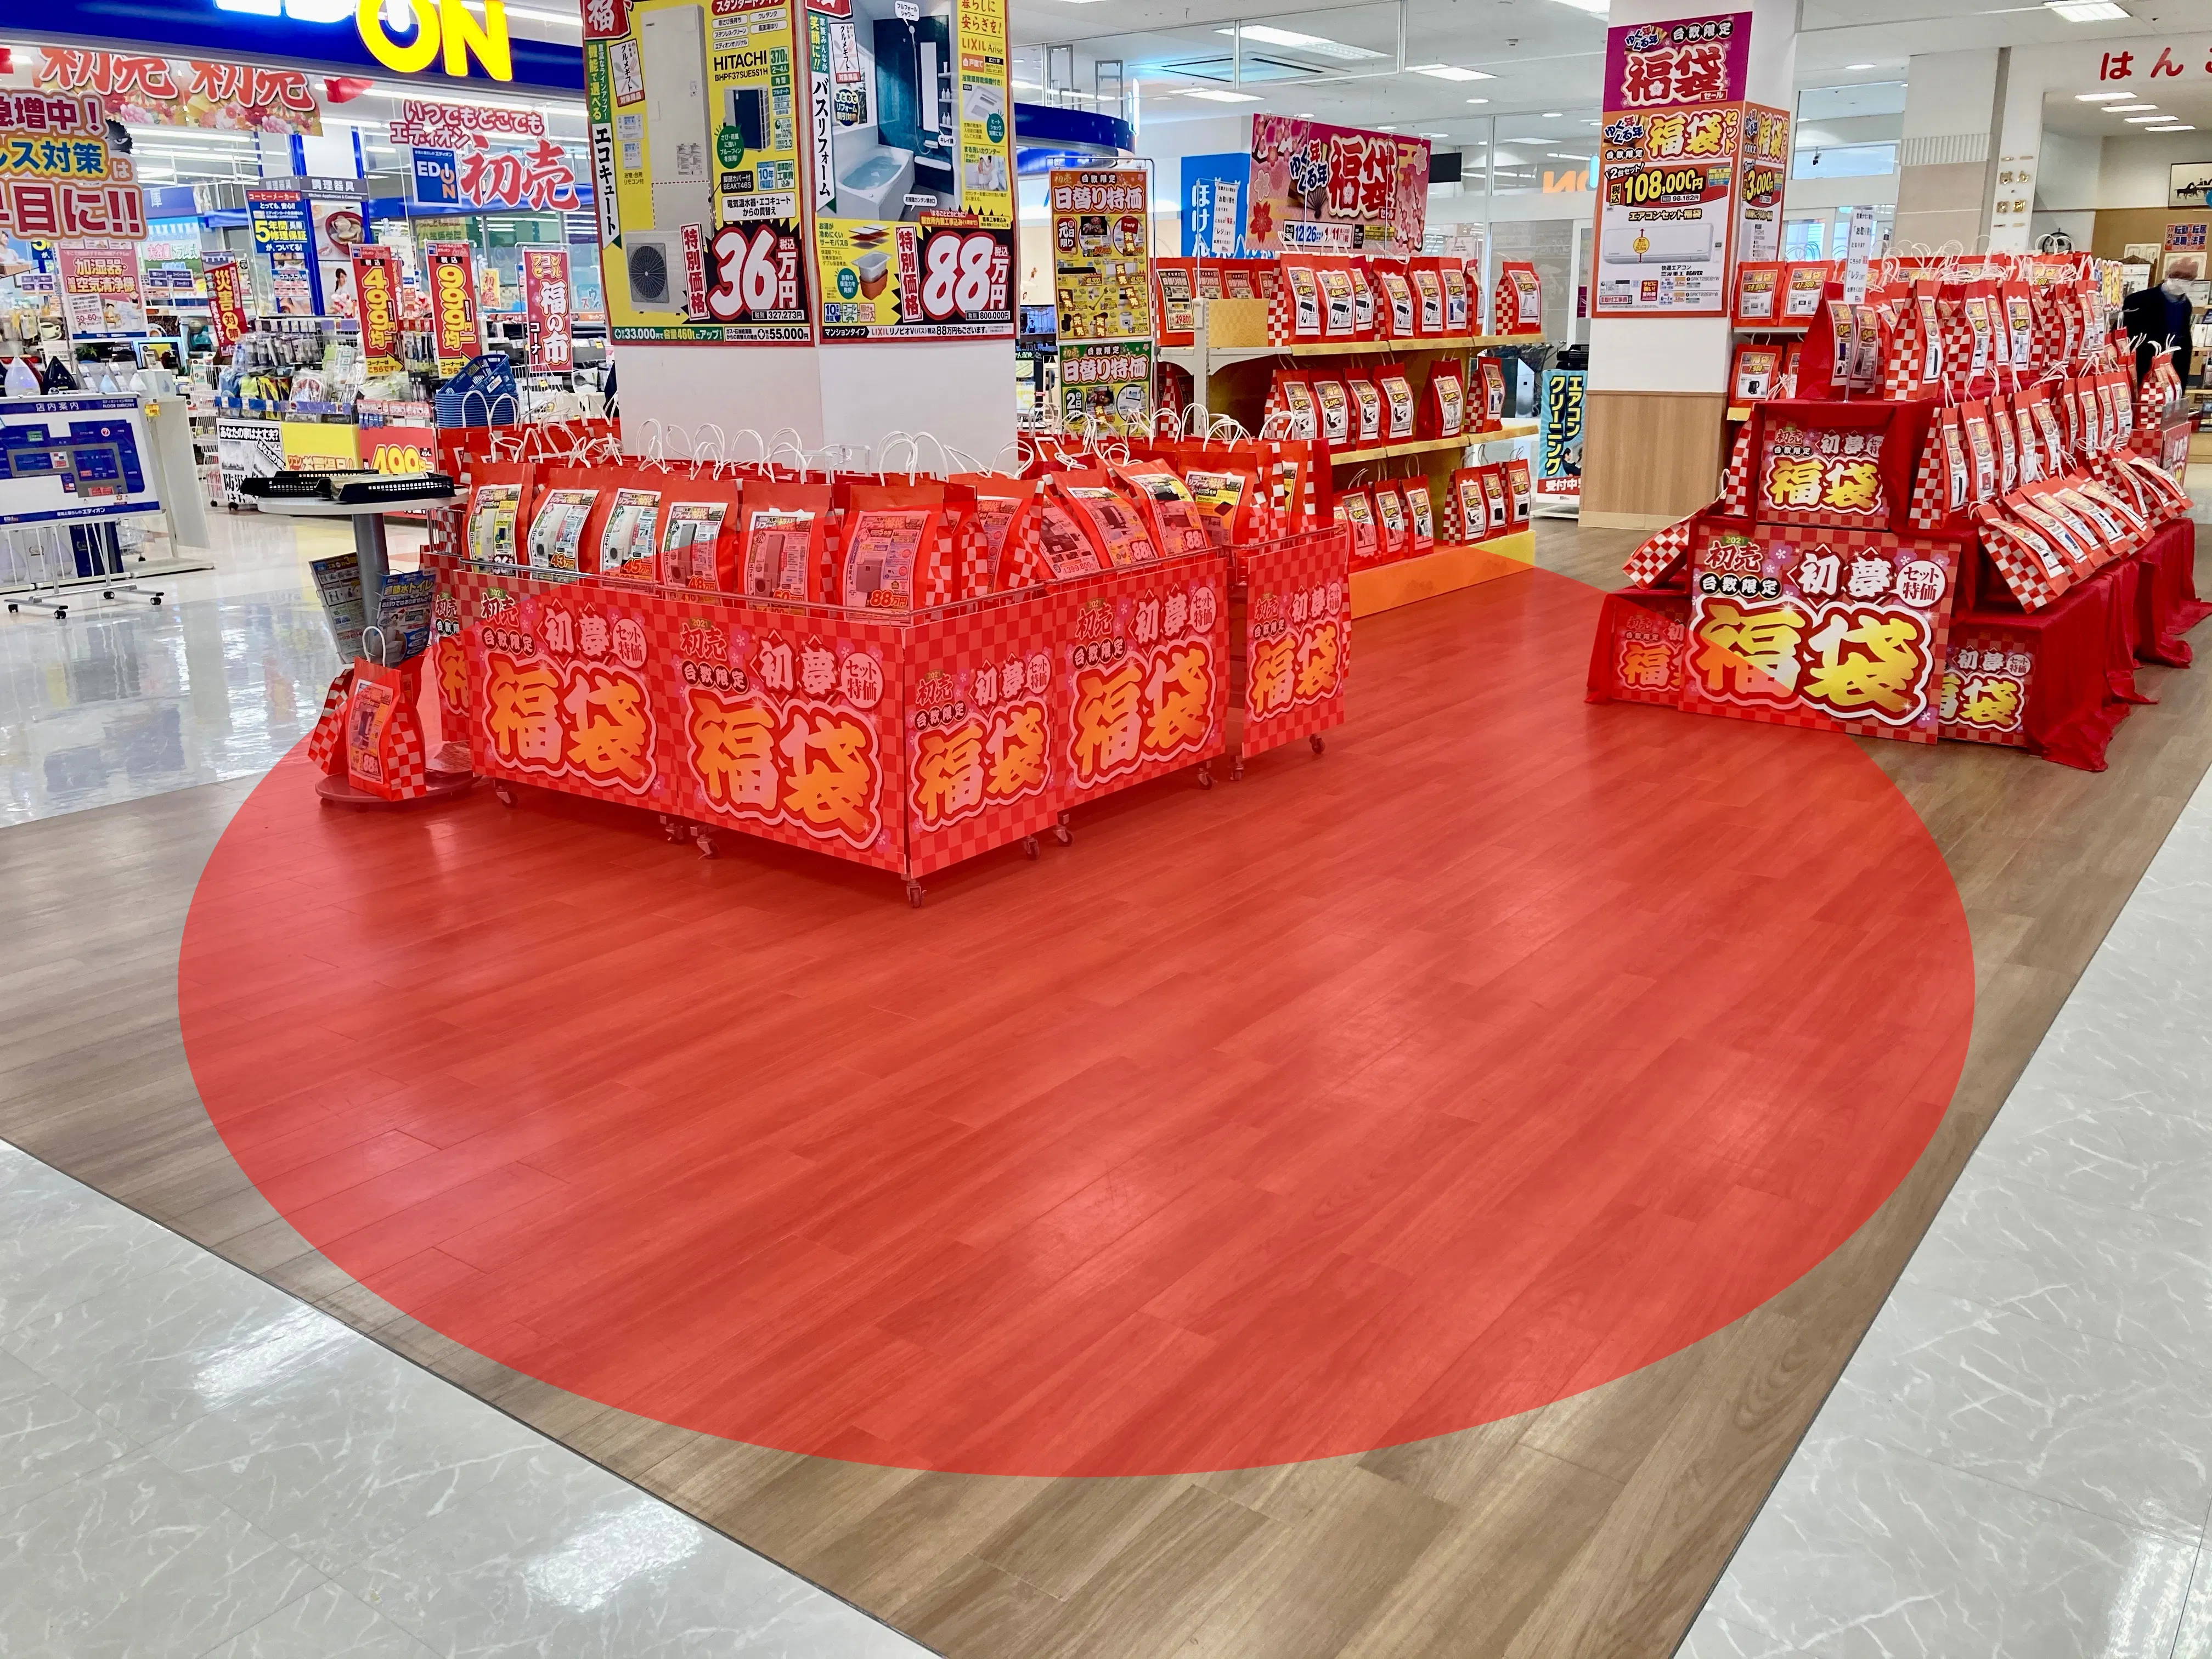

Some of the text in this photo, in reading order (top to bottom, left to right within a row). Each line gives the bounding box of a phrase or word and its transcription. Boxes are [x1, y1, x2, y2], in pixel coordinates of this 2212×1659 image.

[962, 0, 996, 13] 暮らしに
[961, 14, 1002, 34] 安らぎを!
[1672, 21, 1734, 41] 台数限定
[840, 25, 850, 72] グルメギフト
[962, 37, 1003, 55] LIXIL Arise
[621, 44, 633, 92] グルメギフト
[713, 50, 768, 71] HITACHI
[2099, 46, 2212, 81] はん
[1627, 46, 1722, 102] 福袋
[836, 93, 858, 103] まとめて
[1704, 91, 1724, 100] セール
[403, 100, 544, 136] いつでもどこでも
[836, 103, 857, 113] リフォーム
[390, 122, 472, 149] エディオン
[813, 77, 831, 197] バスリフォーム
[1647, 112, 1724, 157] 福袋
[1724, 111, 1739, 155] セット
[459, 132, 580, 212] 初売
[595, 128, 616, 236] エコキュート
[1328, 136, 1397, 217] 福袋
[311, 179, 355, 192] 調理器具
[723, 182, 752, 190] BEAKT46S
[1611, 184, 1621, 204] 税込
[1624, 169, 1704, 204] 108,000円
[727, 196, 791, 208] 電気温水器・エコキュート
[1054, 186, 1144, 210] 日替り特価
[743, 206, 777, 217] からの買替え
[1629, 209, 1702, 221] エアコンセット福袋
[779, 238, 795, 250] 税込
[819, 230, 844, 239] 冷めにくい
[994, 246, 1009, 257] 税込
[684, 229, 706, 315] 特別価格
[710, 228, 778, 317] 36
[898, 230, 921, 317] 特別価格
[923, 235, 994, 317] 88
[540, 280, 569, 363] 福の市
[768, 310, 803, 320] 327,273円
[980, 311, 1010, 320] 800,000円
[530, 322, 541, 365] コーナー
[769, 329, 809, 340] 55,000円
[825, 328, 866, 337] マンションタイプ
[871, 328, 889, 336] LIXIL
[1063, 356, 1148, 382] 日替り特価
[36, 402, 80, 411] 店内案内
[1566, 376, 1584, 437] エアコン
[220, 426, 279, 441] あなたの家は大丈夫?
[1545, 376, 1566, 476] クリーニング
[1775, 427, 1804, 445] 初売
[1773, 445, 1813, 456] 台数限定
[1821, 432, 1866, 455] 初夢
[1545, 478, 1581, 492] 受付中!
[1772, 459, 1882, 509] 福袋
[1725, 537, 1746, 545] 2021
[1705, 542, 1763, 572] 初売
[1701, 574, 1781, 597] 台数限定
[1799, 553, 1895, 598] 初夢
[1903, 566, 1939, 585] セット
[488, 588, 505, 597] 2021
[870, 589, 908, 606] 88万円
[1193, 594, 1215, 611] セット
[1903, 582, 1938, 601] 特価
[481, 592, 520, 627] 初売
[1087, 599, 1103, 608] 2021
[690, 618, 710, 629] 2021
[1074, 602, 1115, 639] 初売
[1134, 591, 1189, 645] 初夢
[1193, 606, 1214, 627] 特価
[483, 627, 536, 657] 台数限定
[543, 605, 610, 658] 初夢
[615, 624, 641, 644] セット
[680, 622, 728, 662] 初売
[617, 641, 642, 660] 特価
[1073, 637, 1125, 669] 台数限定
[1697, 600, 1920, 718] 福袋
[1957, 650, 2005, 672] 初夢
[2009, 656, 2029, 665] セット
[682, 661, 748, 693] 台数限定
[759, 639, 837, 696] 初夢
[845, 659, 878, 681] セット
[926, 670, 943, 679] 2021
[1029, 659, 1048, 674] セット
[1253, 623, 1339, 712] 福袋
[1622, 645, 1683, 688] 福
[2009, 663, 2028, 674] 特価
[847, 678, 878, 703] 特価
[916, 674, 955, 706] 初売
[974, 658, 1026, 704] 初夢
[1029, 670, 1048, 688] 特価
[488, 656, 649, 783] 福袋
[916, 702, 966, 730] 台数限定
[1073, 645, 1209, 779] 福袋
[694, 693, 873, 837] 福袋
[916, 703, 1047, 823] 福袋
